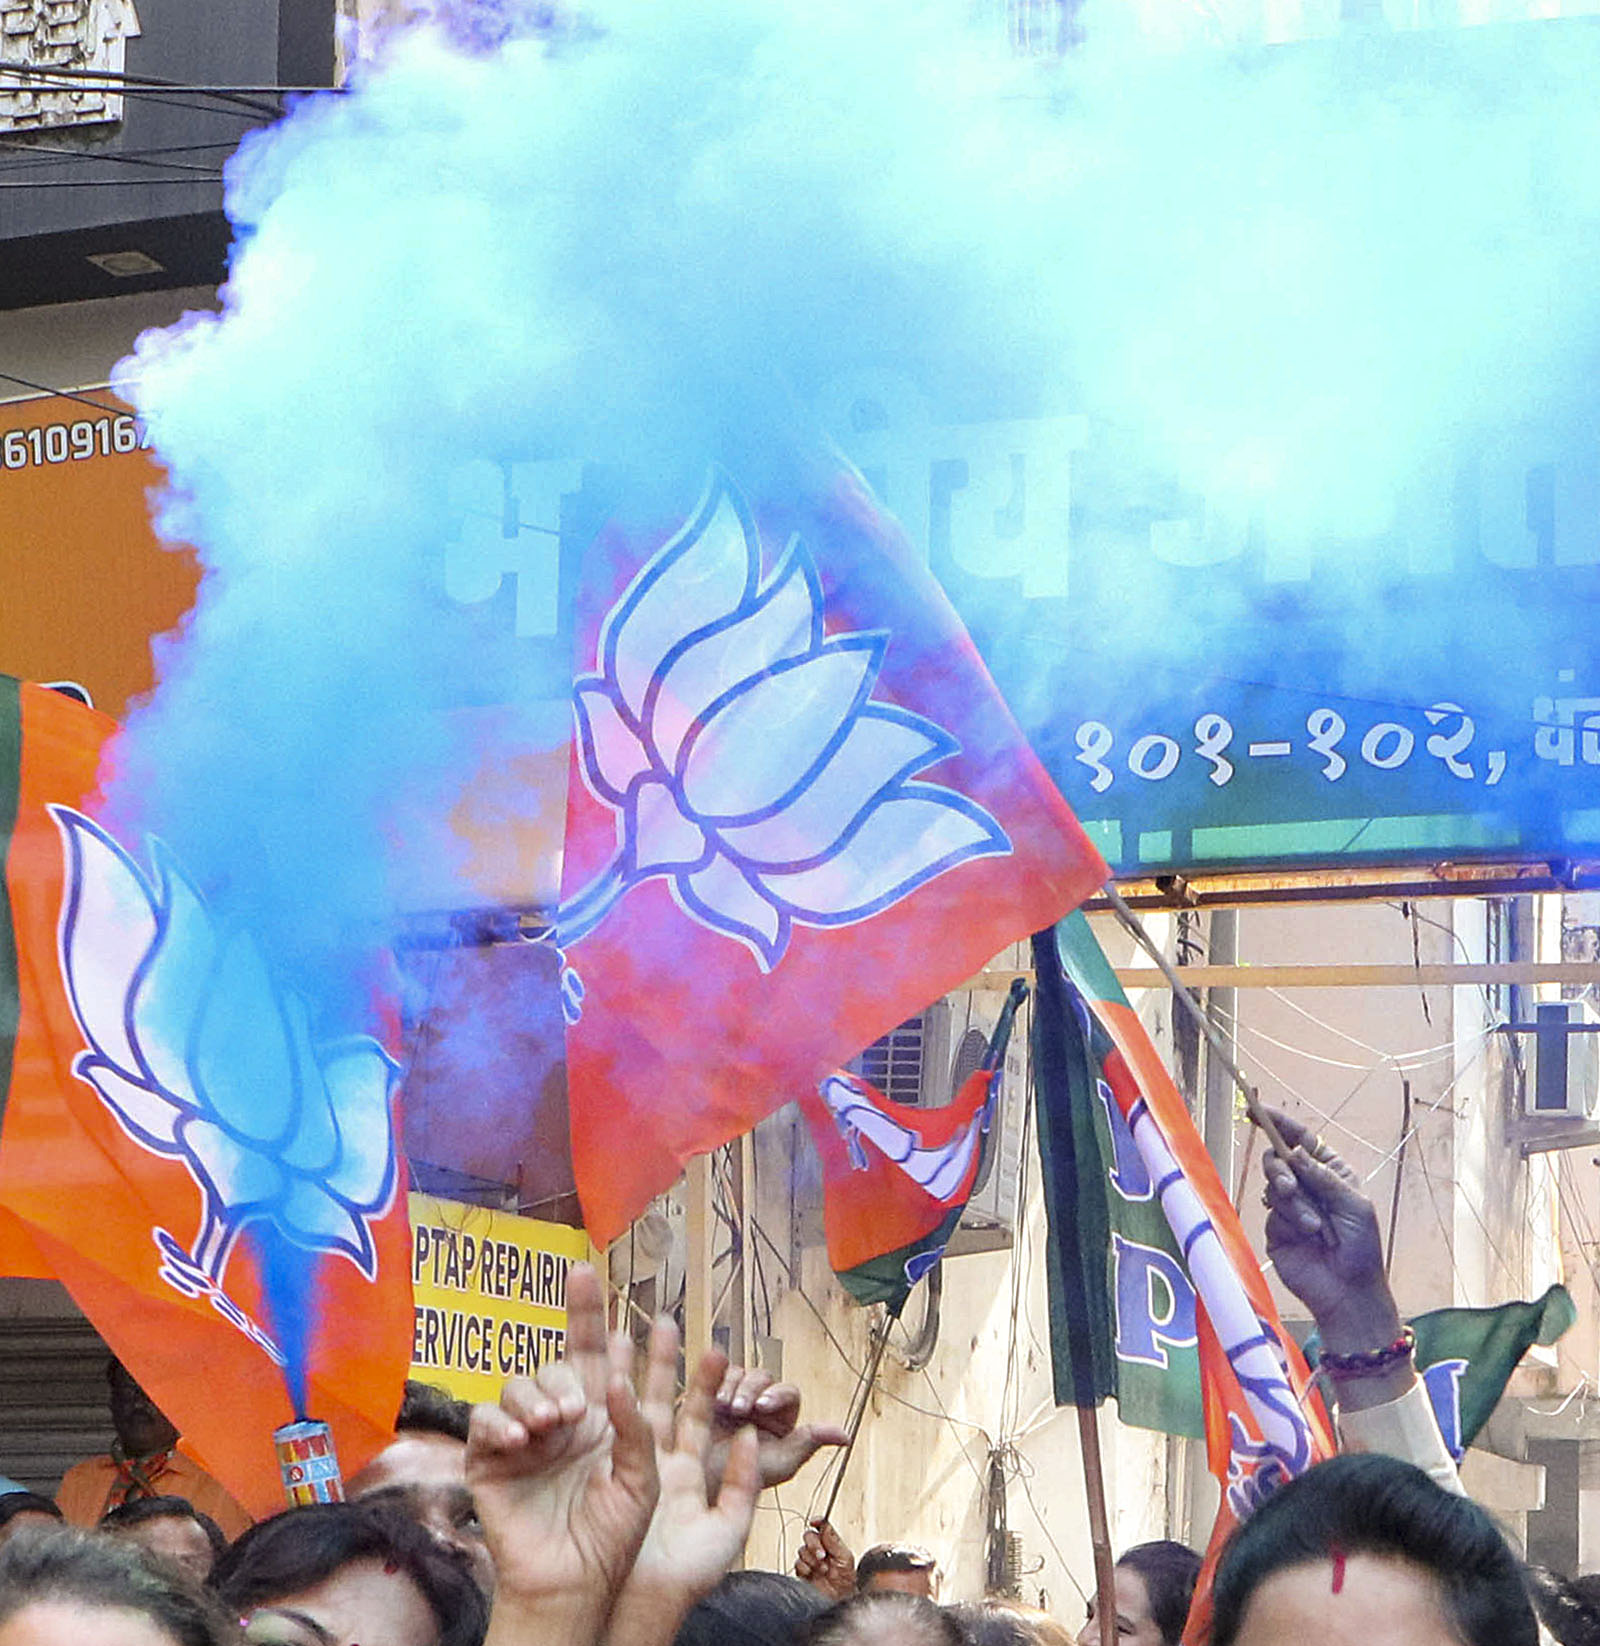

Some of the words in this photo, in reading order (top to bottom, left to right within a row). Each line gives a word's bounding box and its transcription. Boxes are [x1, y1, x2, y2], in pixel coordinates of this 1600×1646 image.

[411, 1224, 478, 1293] PTAP
[479, 1237, 574, 1312] REPAIRIN
[497, 1319, 567, 1378] CENTE
